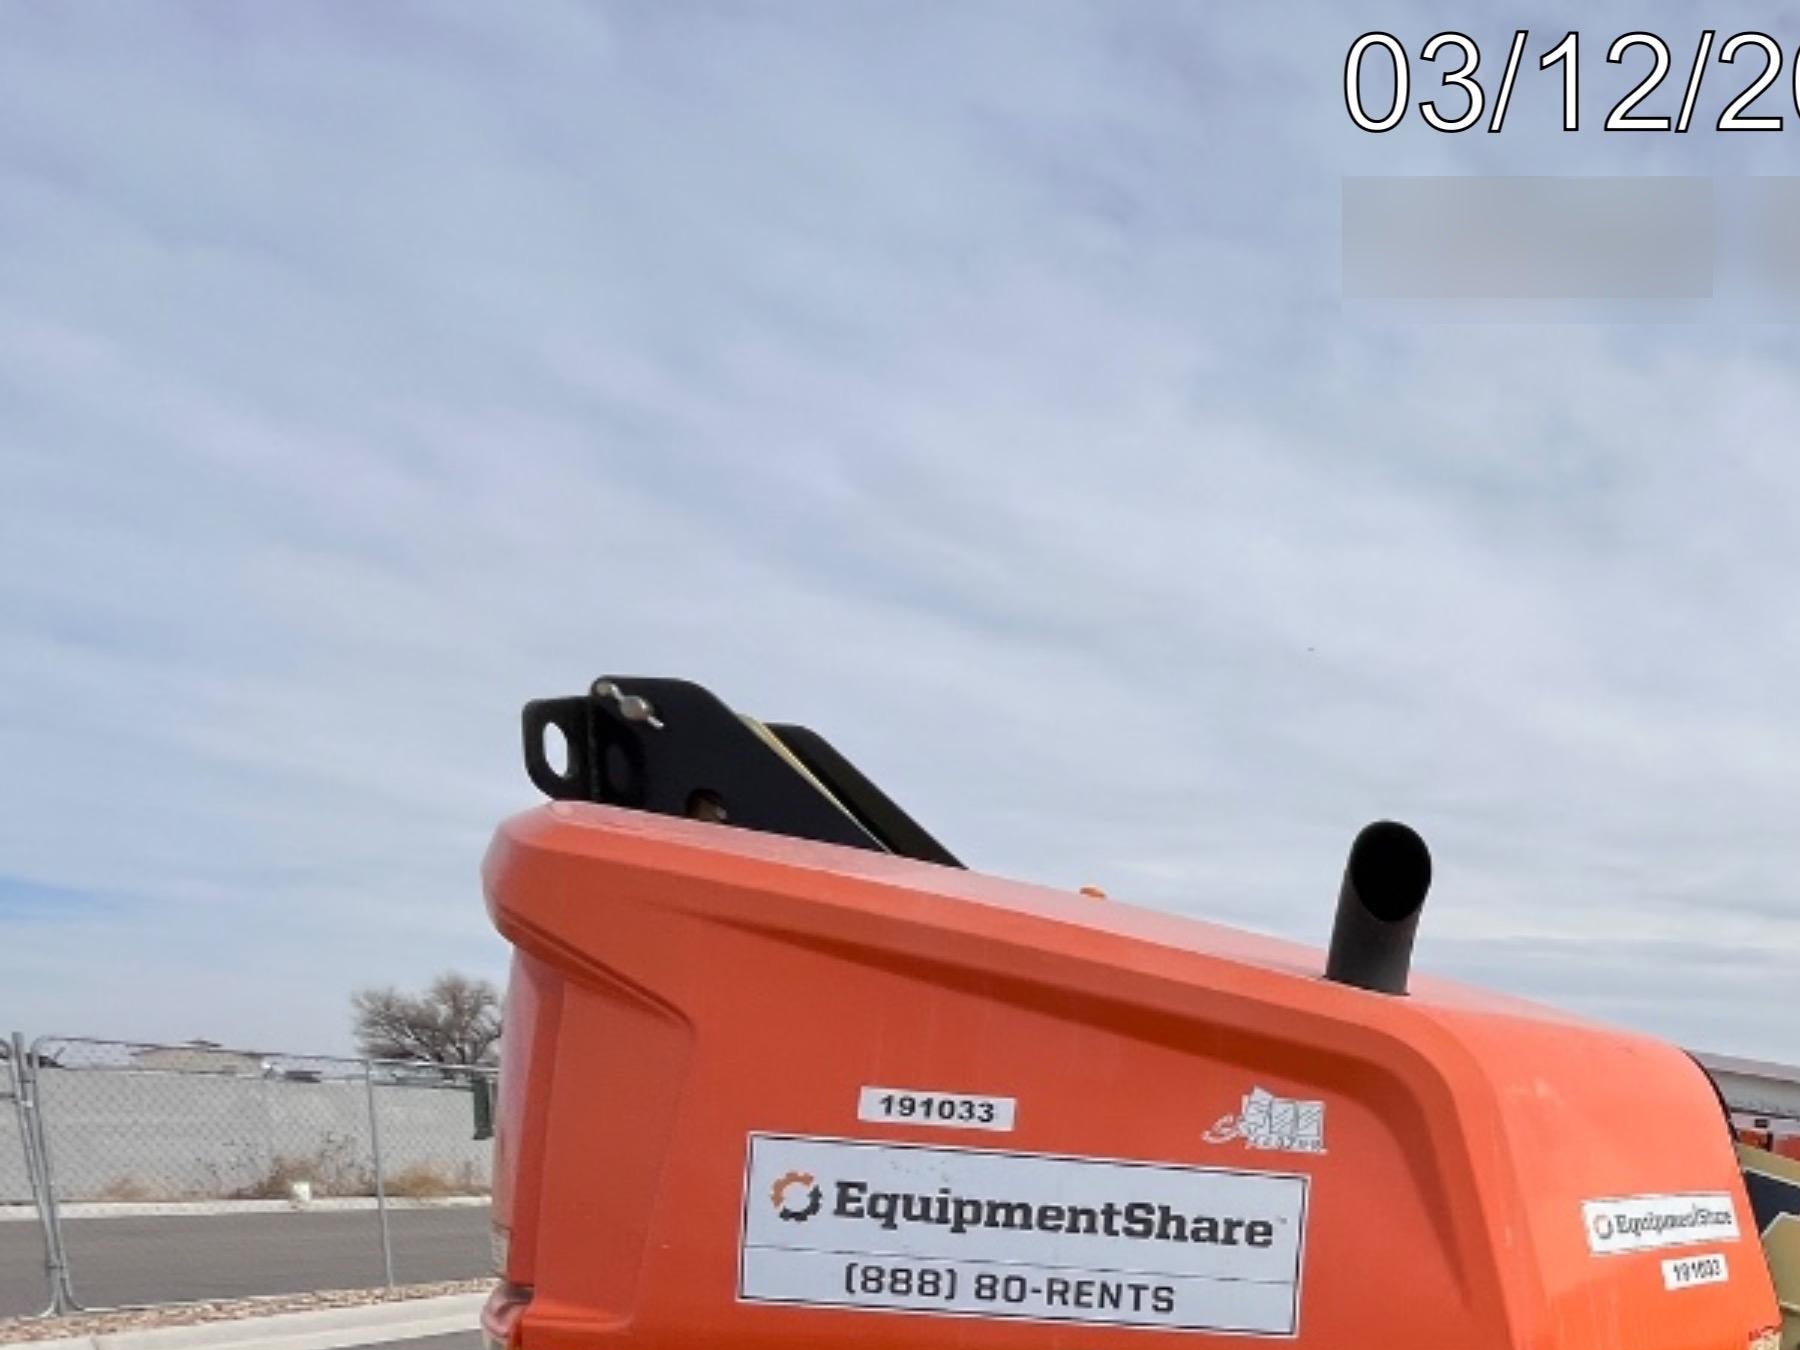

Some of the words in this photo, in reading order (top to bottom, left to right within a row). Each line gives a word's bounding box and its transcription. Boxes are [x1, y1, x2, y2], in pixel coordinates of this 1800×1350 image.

[879, 1094, 995, 1123] 191033
[832, 1180, 1274, 1249] EquipmentShare
[845, 1262, 958, 1301] (888)
[974, 1273, 1175, 1314] 80-RENTS
